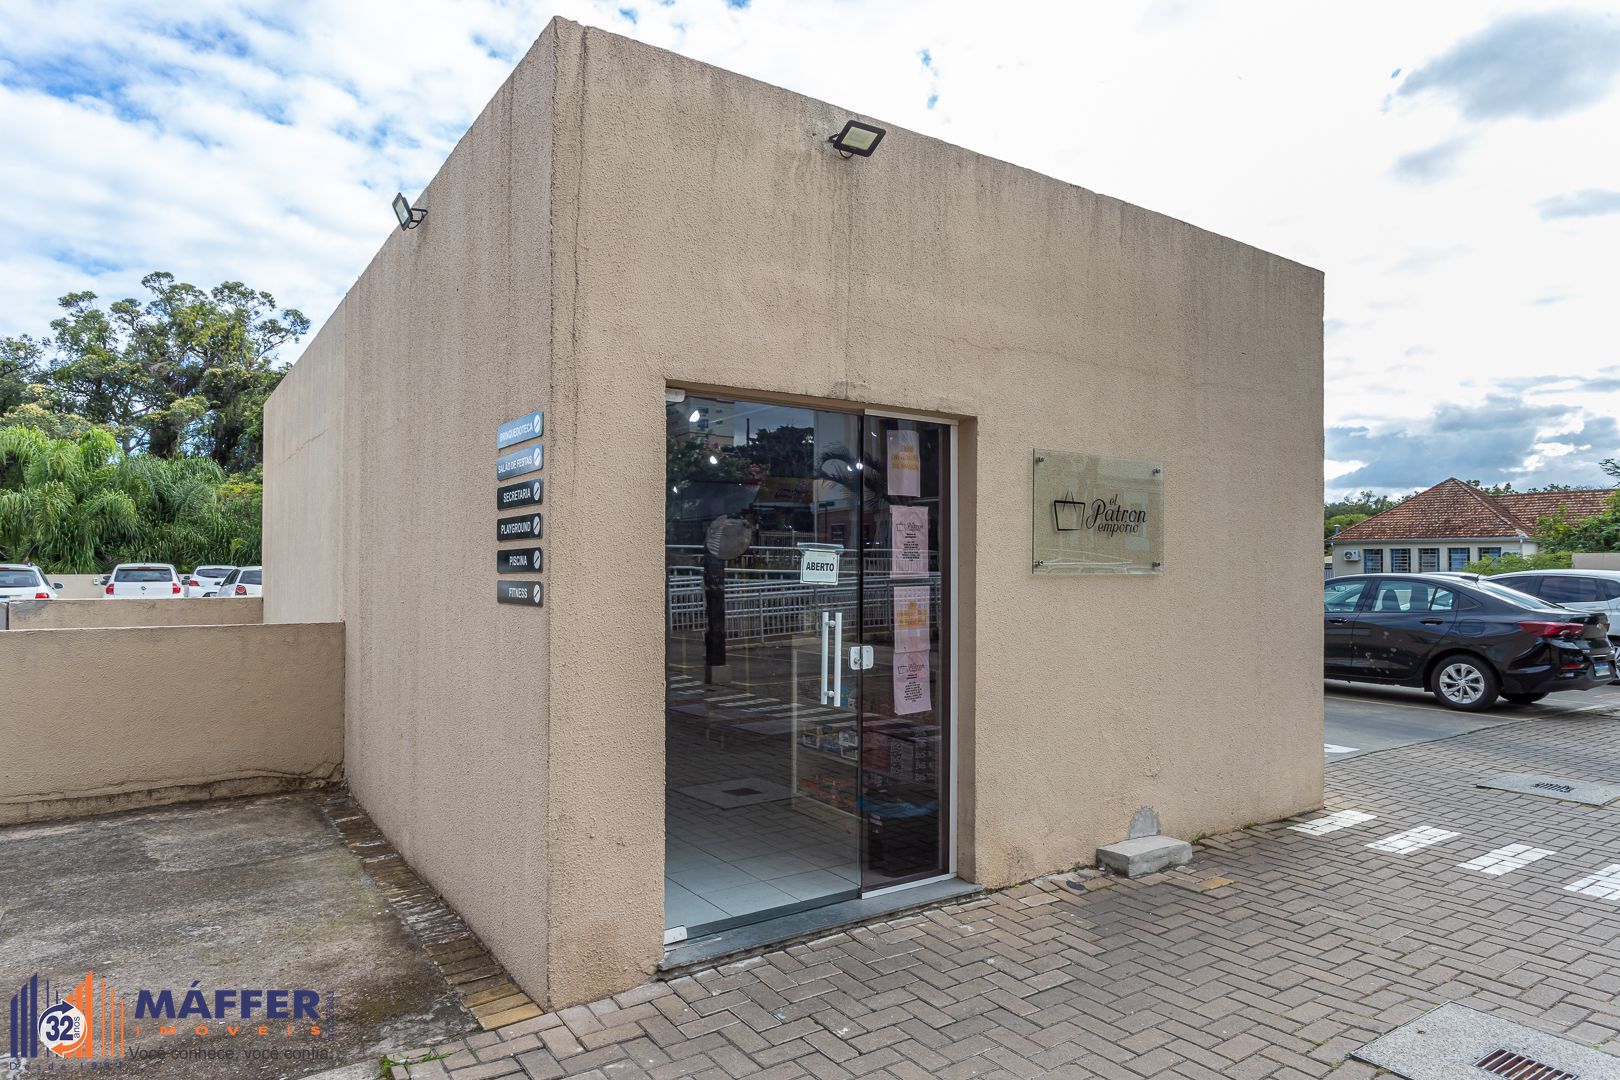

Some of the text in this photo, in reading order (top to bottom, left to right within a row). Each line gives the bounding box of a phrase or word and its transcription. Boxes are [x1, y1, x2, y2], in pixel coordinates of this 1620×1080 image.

[516, 455, 532, 469] FESTAS
[503, 488, 531, 503] SECRETARIA
[1110, 494, 1118, 505] el
[1086, 498, 1147, 530] Patron
[501, 521, 531, 535] PLAYGROUND
[509, 555, 528, 566] PISCINA
[805, 561, 836, 572] ABERTO
[508, 587, 528, 599] FITNESS
